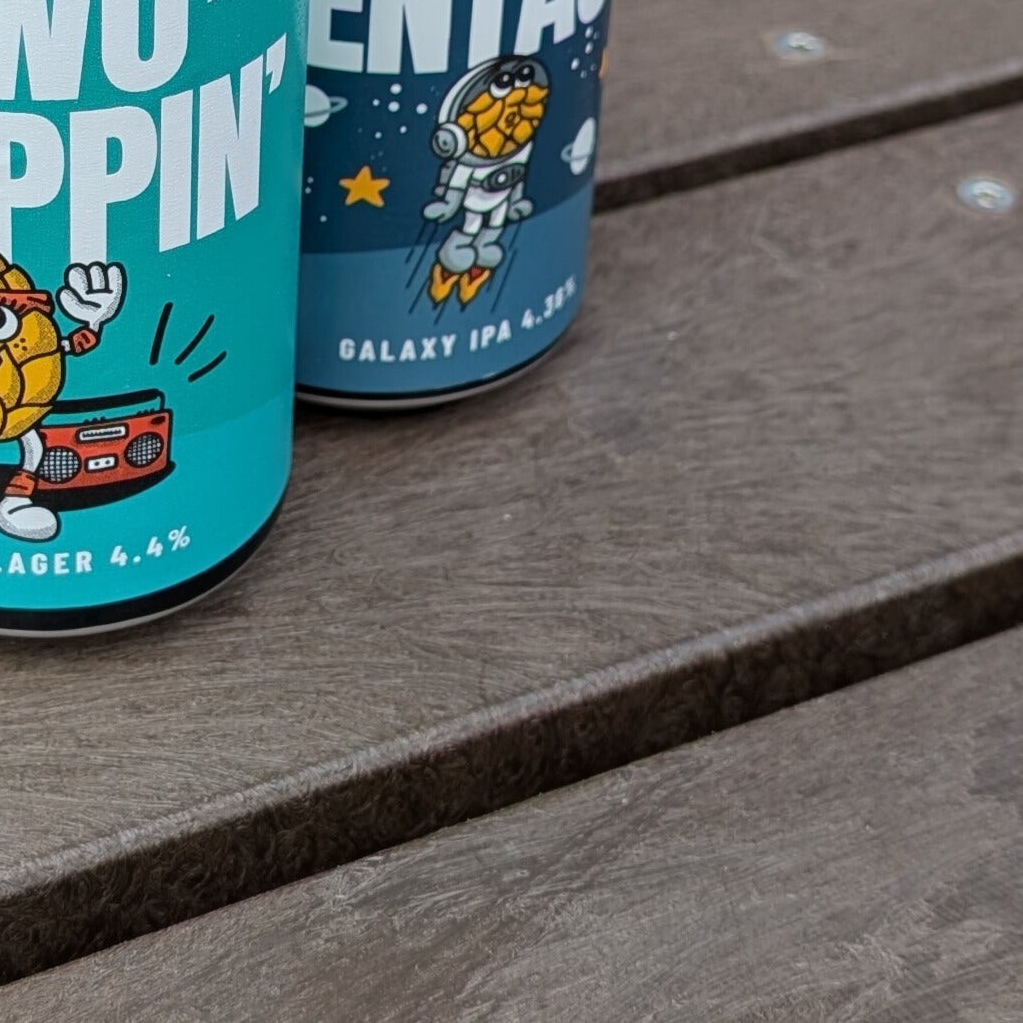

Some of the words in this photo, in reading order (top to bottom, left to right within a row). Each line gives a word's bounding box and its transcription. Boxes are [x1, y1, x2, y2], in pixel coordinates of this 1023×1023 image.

[338, 334, 457, 362] GALAXY
[469, 319, 513, 353] IPA
[109, 525, 192, 568] 4.4%
